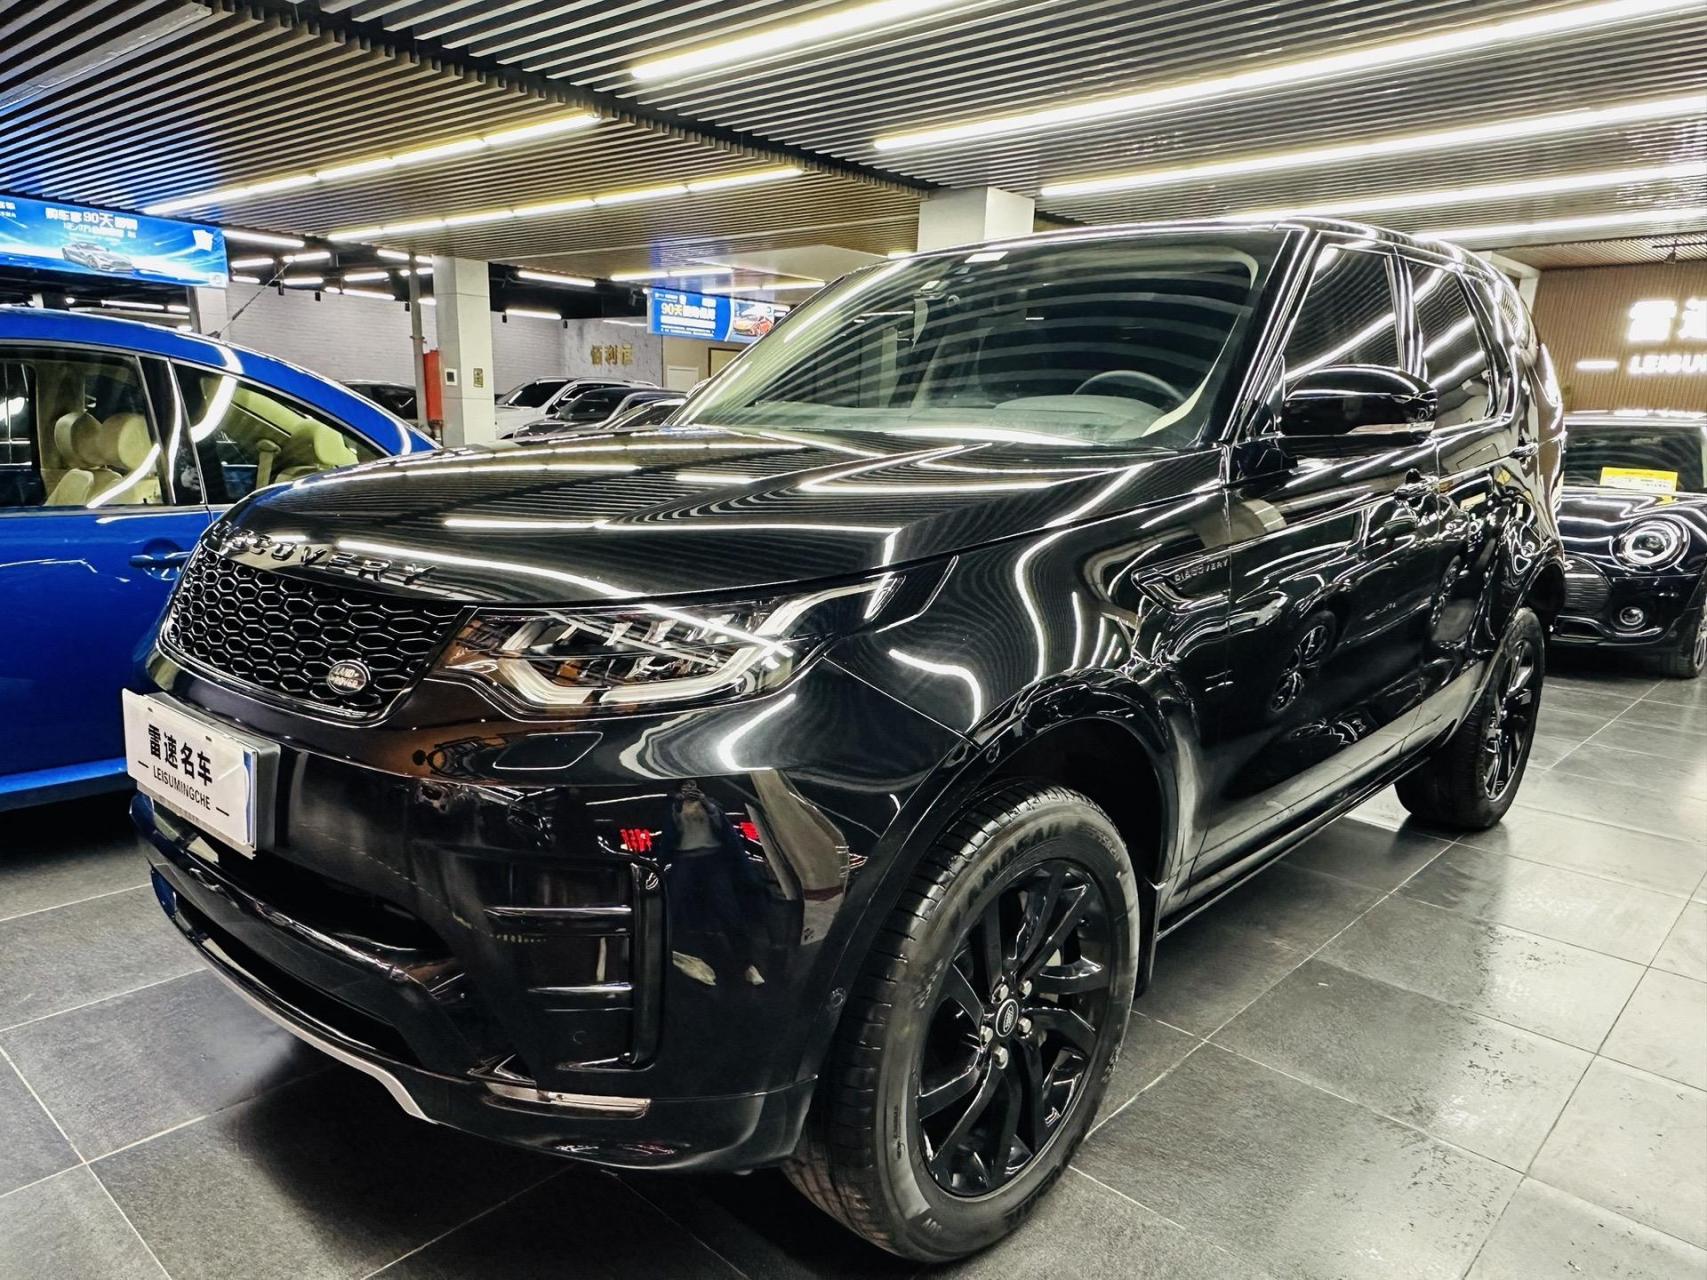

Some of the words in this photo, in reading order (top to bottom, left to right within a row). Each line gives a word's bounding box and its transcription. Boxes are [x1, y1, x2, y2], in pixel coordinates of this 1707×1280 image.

[147, 723, 213, 787] 雷速名车
[153, 764, 212, 811] LEISUMINGCHE
